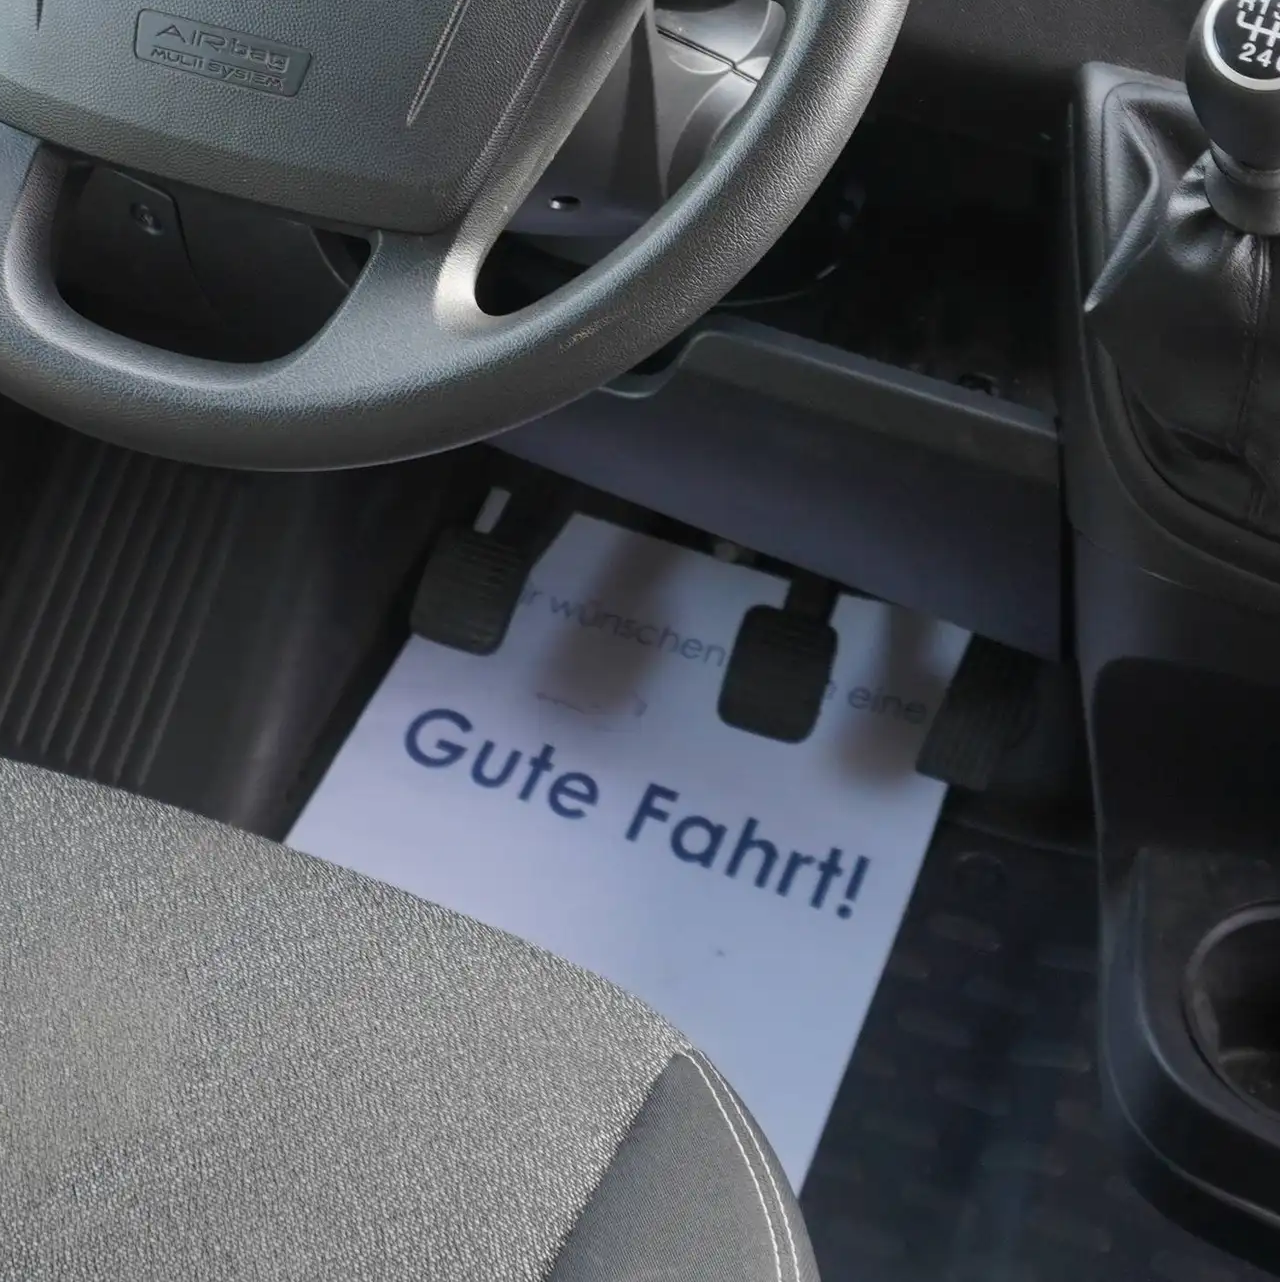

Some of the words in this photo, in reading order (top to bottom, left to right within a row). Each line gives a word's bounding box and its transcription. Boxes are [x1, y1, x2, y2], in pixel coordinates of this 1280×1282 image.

[1238, 42, 1257, 63] 2
[1256, 49, 1273, 68] 4
[403, 707, 600, 821] Gute
[623, 782, 871, 920] Fahrt!
